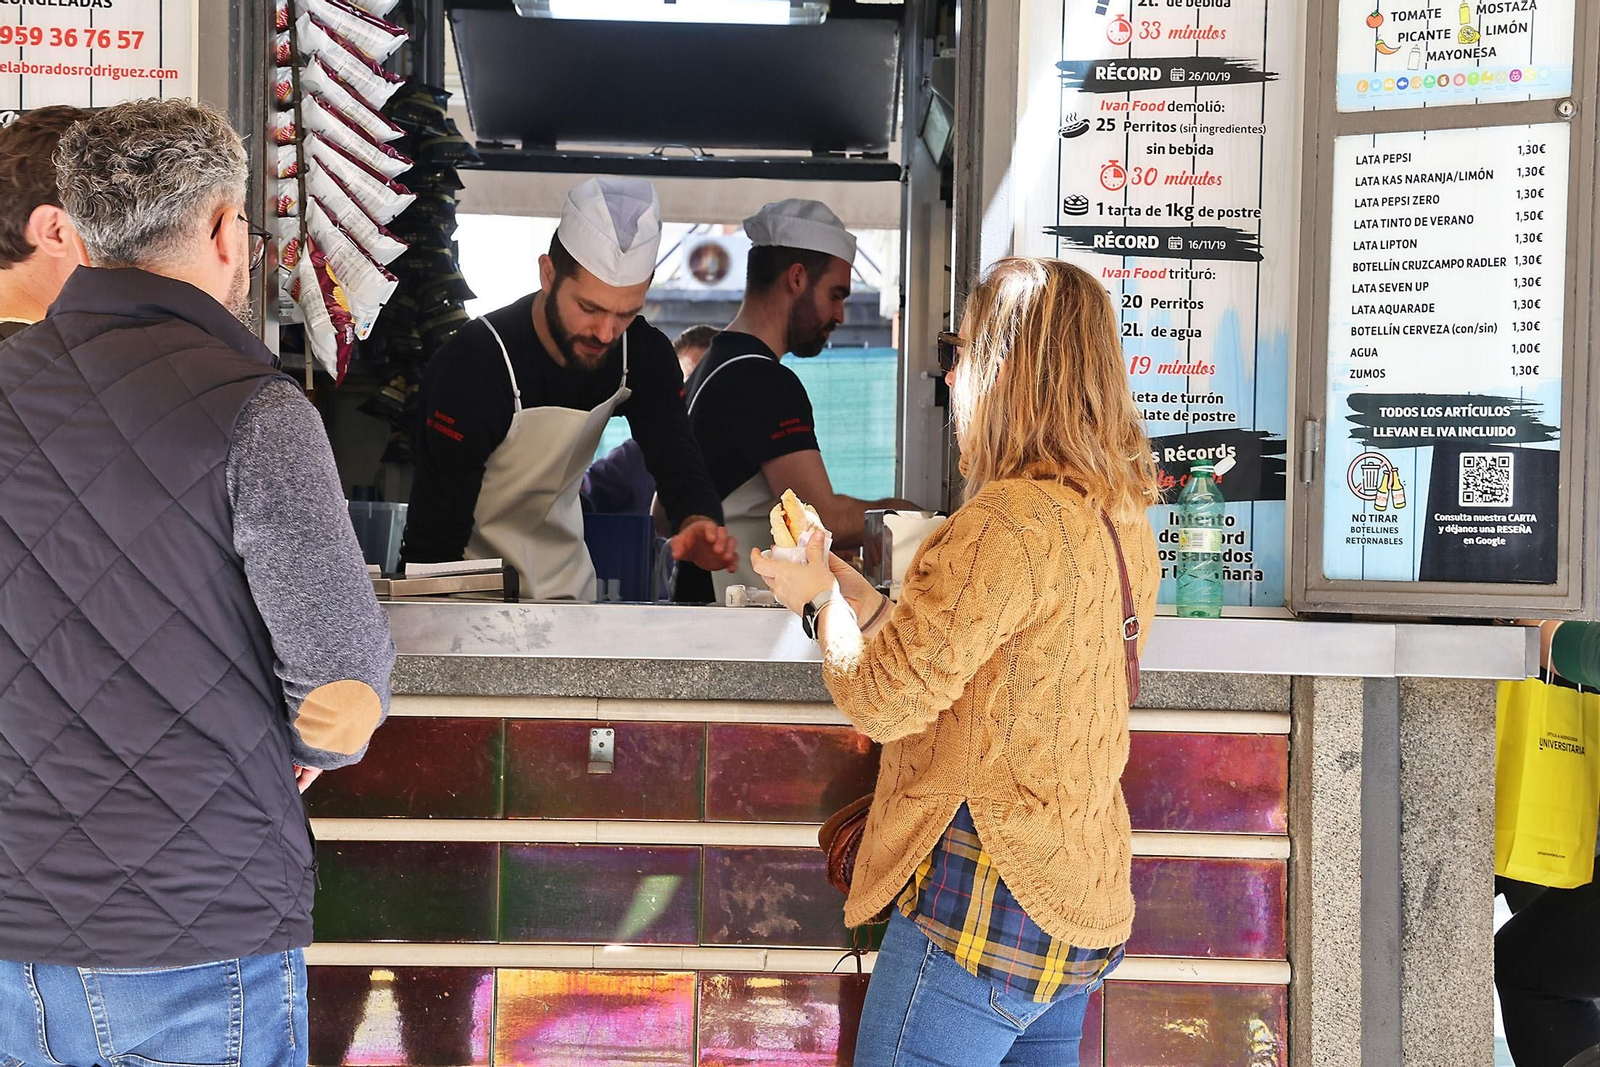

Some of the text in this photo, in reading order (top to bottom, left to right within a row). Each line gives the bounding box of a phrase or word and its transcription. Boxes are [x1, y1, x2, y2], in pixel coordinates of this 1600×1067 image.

[1476, 0, 1537, 15] MOSTAZA
[1391, 8, 1442, 22] TOMATE
[1139, 21, 1226, 40] 33 minutos
[1486, 20, 1528, 36] LIMÓN
[0, 26, 144, 50] 959 36 76 57
[1398, 29, 1451, 42] PICANTE
[1426, 47, 1496, 62] MAYONESA
[0, 61, 178, 81] elaboradosrodriguez.com
[1095, 62, 1231, 82] RÉCORD 26/10/19
[1101, 100, 1225, 112] Ivan Food demolió:
[1096, 118, 1267, 136] 25 Perritos (sin ingredientes)
[1147, 143, 1214, 156] sin bebida
[1517, 144, 1546, 156] 1,30€
[1356, 153, 1412, 165] LATA PEPSI
[1131, 167, 1222, 186] 30 minutos
[1355, 168, 1494, 187] LATA KAS NARANJA/LIMÓN
[1517, 166, 1546, 178] 1,30€
[1354, 194, 1440, 208] LATA PEPSI ZERO
[1516, 189, 1544, 200] 1,30€
[1096, 202, 1261, 221] 1 tarta de 1kg de postre
[1515, 211, 1544, 222] 1,50€
[1354, 215, 1474, 229] LATA TINTO DE VERANO
[1093, 230, 1226, 250] RÉCORD 16/11/19
[1353, 239, 1417, 251] LATA LIPTON
[1514, 233, 1543, 245] 1,30€
[1352, 257, 1507, 272] BOTELLÍN CRUZCAMPO RADLER
[1514, 255, 1542, 266] 1,30€
[1102, 267, 1216, 280] Ivan Food trituró:
[1352, 282, 1429, 294] LATA SEVEN UP
[1513, 277, 1542, 288] 1,30€
[1122, 295, 1204, 309] 20 Perritos
[1513, 299, 1541, 311] 1,30€
[1351, 303, 1435, 316] LATA AQUARADE
[1123, 323, 1202, 340] 2l. de agua
[1351, 322, 1498, 337] BOTELLÍN CERVEZA (con/sin)
[1512, 321, 1541, 332] 1,30€
[1350, 348, 1378, 357] AGUA
[1512, 343, 1541, 355] 1,00€
[1130, 356, 1215, 375] 19 minutos
[1511, 366, 1539, 377] 1,30€
[1350, 369, 1386, 379] ZUMOS
[1162, 392, 1178, 403] de
[1181, 392, 1223, 404] turrón
[1173, 410, 1189, 421] de
[1193, 411, 1236, 424] postre
[1379, 403, 1511, 418] TODOS LOS ARTÍCULOS
[1373, 426, 1516, 438] LLEVAN EL IVA INCLUIDO
[1164, 444, 1236, 462] Récords
[1352, 514, 1398, 523] NO TIRAR
[1434, 513, 1537, 522] Consulta nuestra CARTA
[1351, 526, 1399, 534] BOTELLINES
[1438, 523, 1532, 535] y déjanos una RESEÑA
[1346, 537, 1403, 545] RETORNABLES
[1476, 537, 1506, 547] Google
